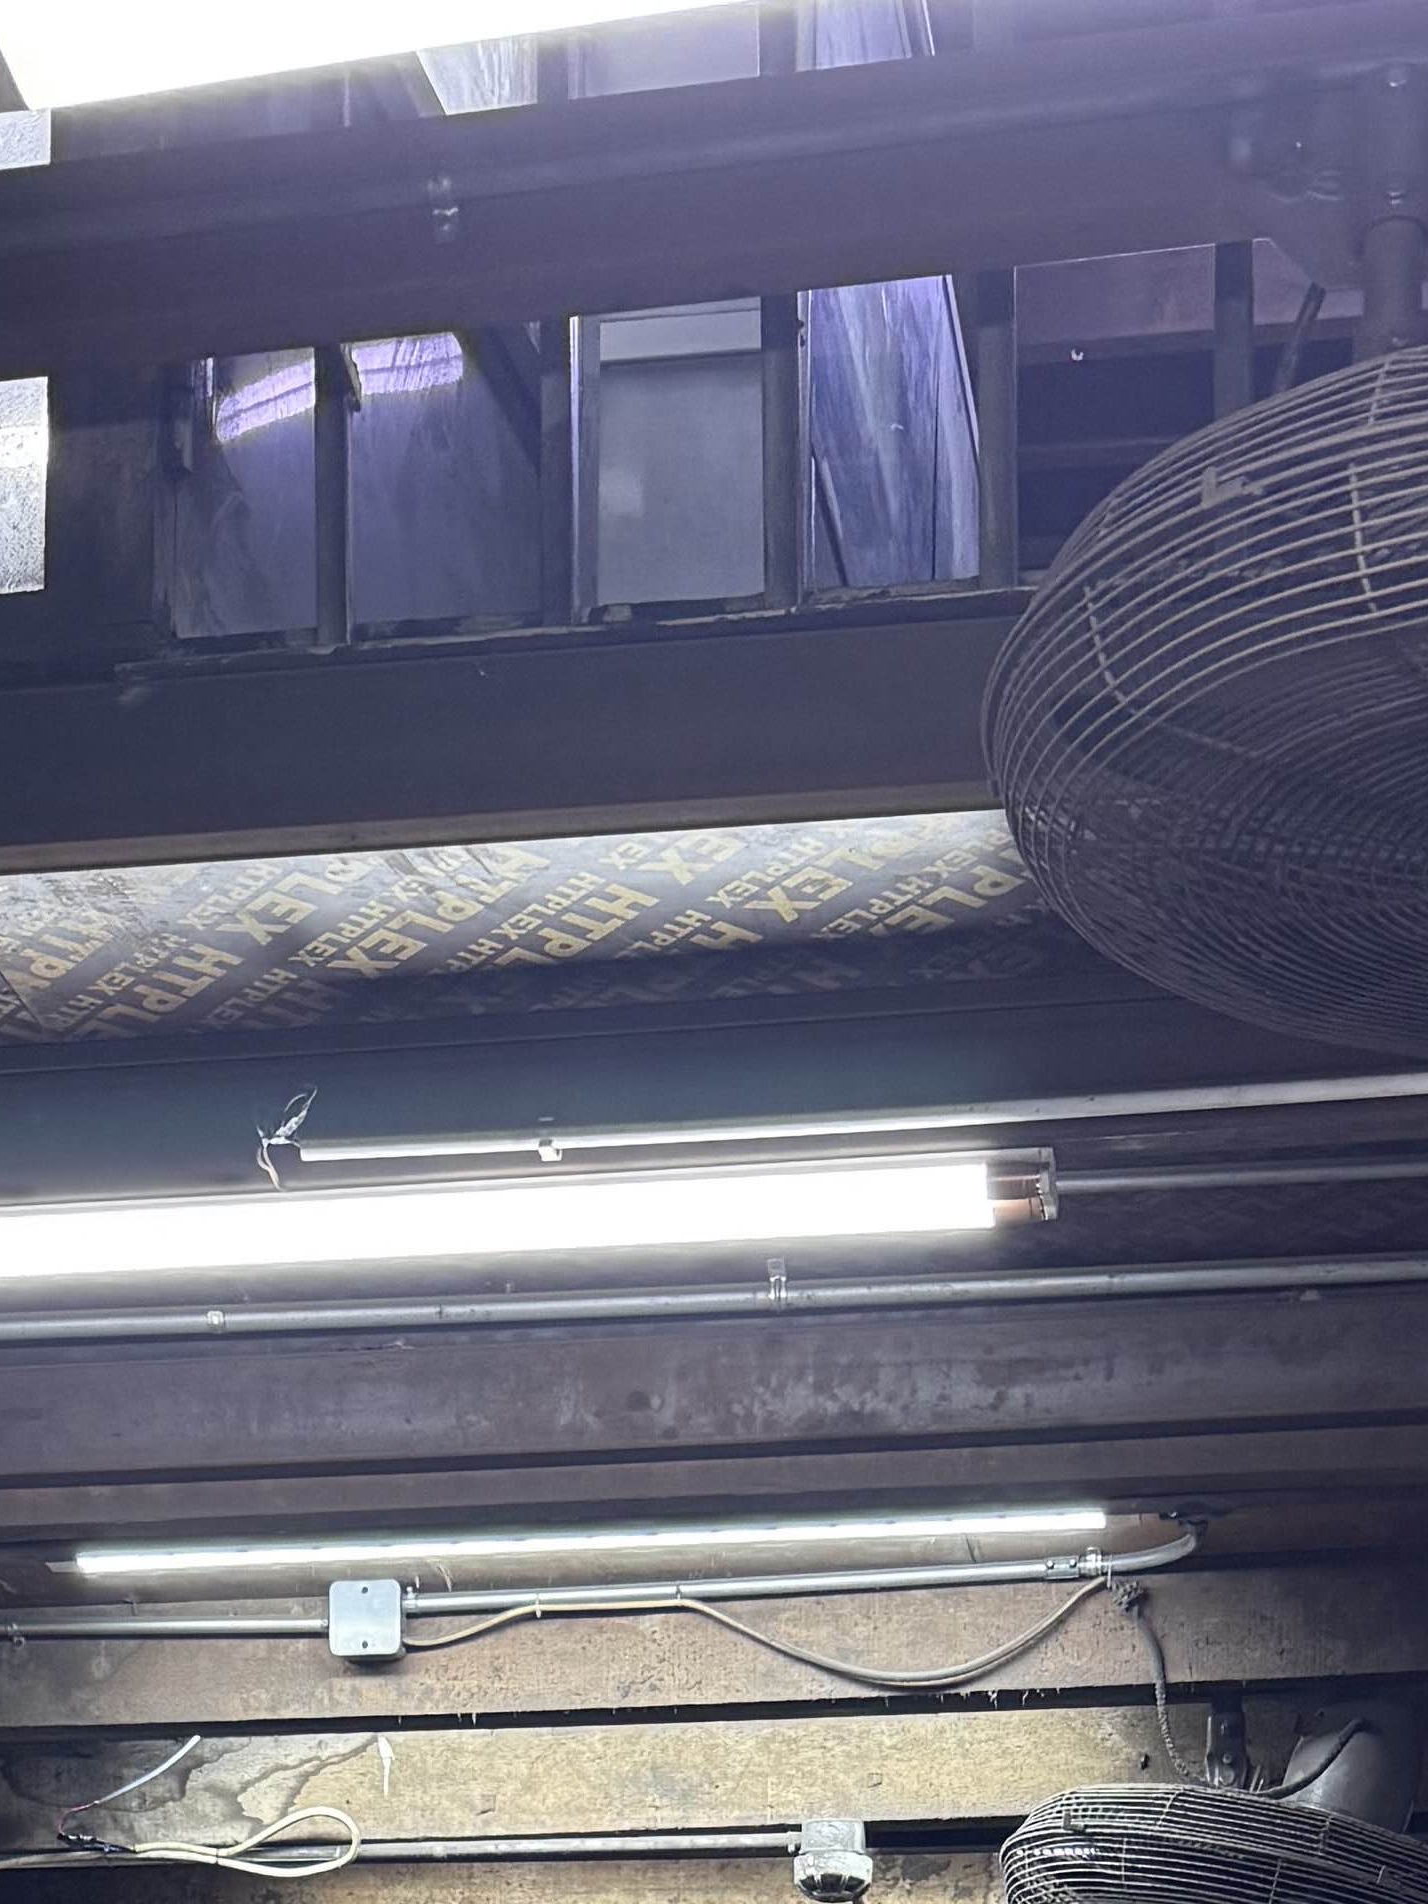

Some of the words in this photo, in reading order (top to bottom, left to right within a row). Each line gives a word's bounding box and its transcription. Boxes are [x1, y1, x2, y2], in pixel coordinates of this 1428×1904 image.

[288, 901, 396, 968] HTPLEX
[491, 872, 606, 940] HTPLEX
[493, 883, 660, 967] HTPL
